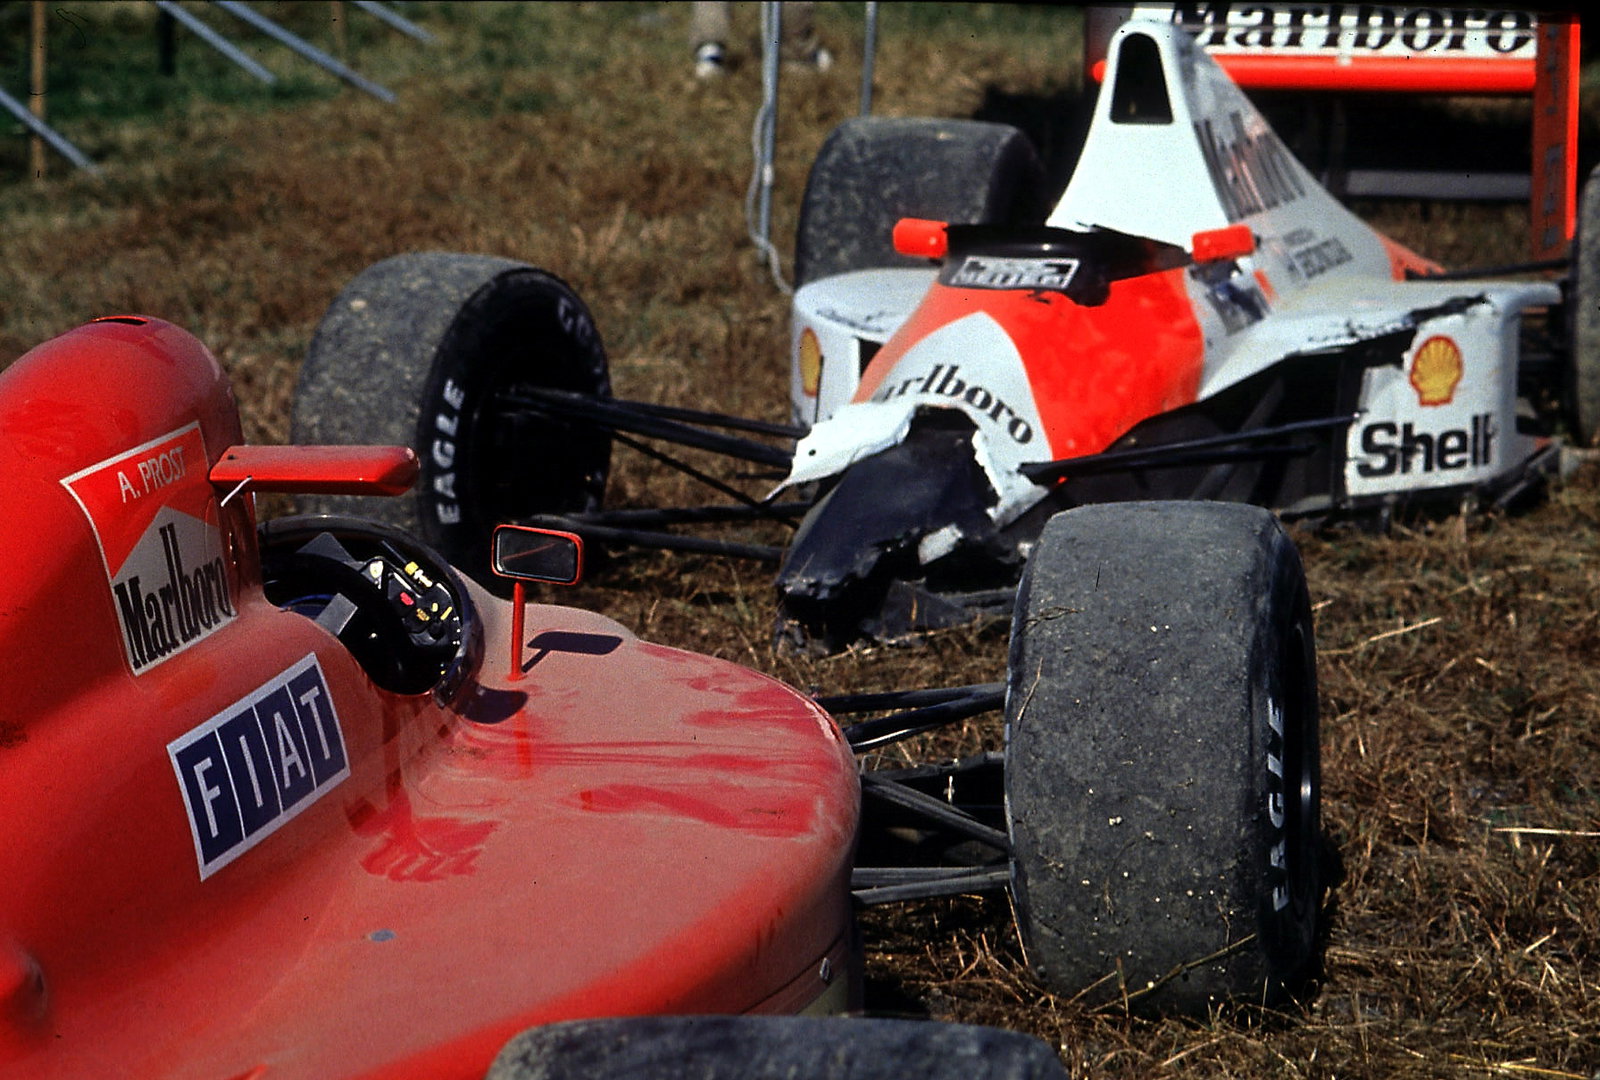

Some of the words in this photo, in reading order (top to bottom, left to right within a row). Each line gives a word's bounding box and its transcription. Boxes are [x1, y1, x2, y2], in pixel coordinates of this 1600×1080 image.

[117, 471, 141, 503] A.
[137, 447, 187, 495] PROST
[433, 378, 465, 524] EAGLE
[884, 363, 1034, 445] rlboro
[1356, 412, 1493, 478] Shell
[114, 522, 238, 670] Marlboro
[193, 685, 331, 839] FIAT
[1267, 697, 1290, 912] EAGLE
